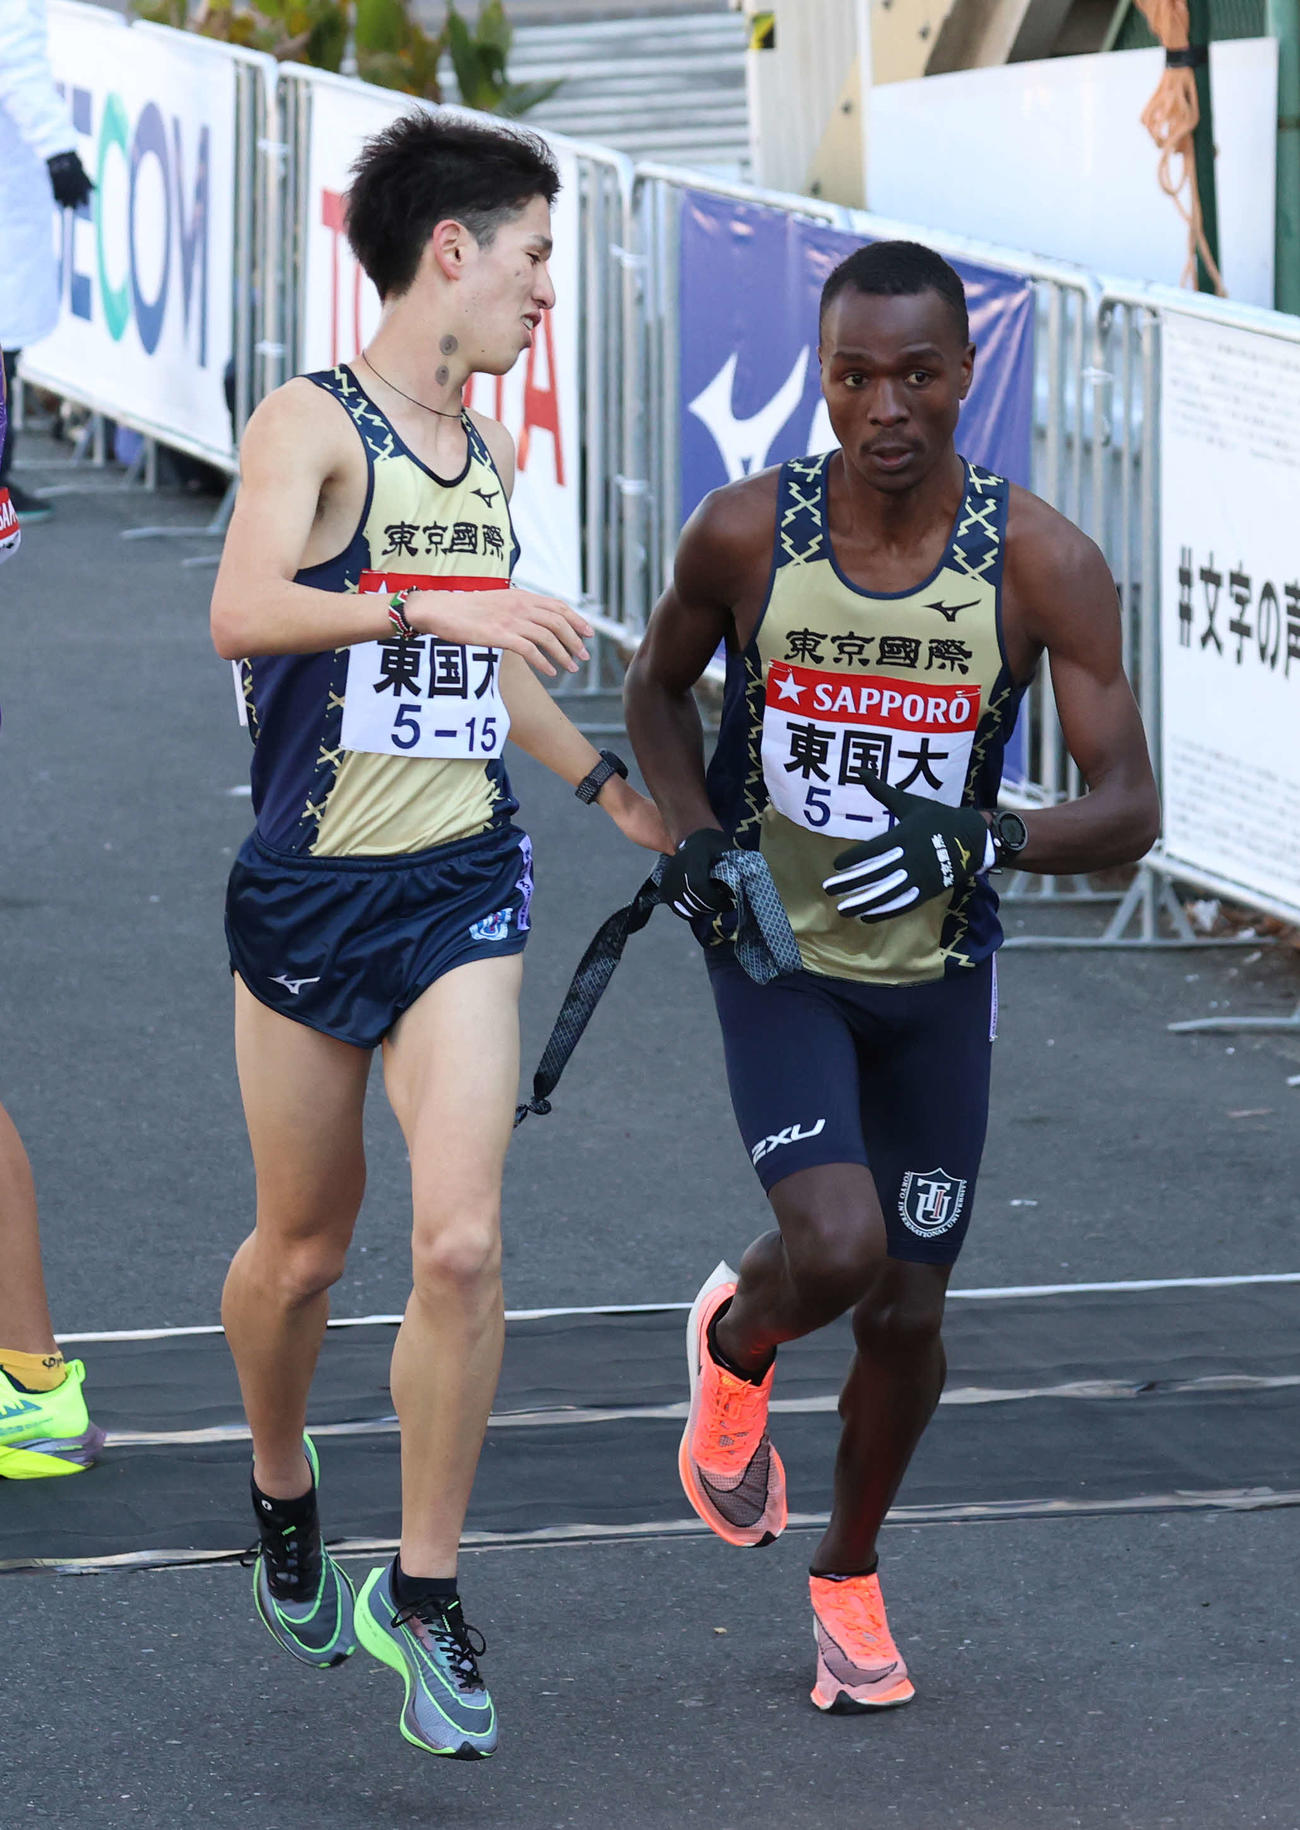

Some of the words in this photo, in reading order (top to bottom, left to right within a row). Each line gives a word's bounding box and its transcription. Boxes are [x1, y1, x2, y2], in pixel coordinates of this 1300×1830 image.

[54, 80, 210, 369] ECOM
[373, 637, 499, 700] 東国大
[784, 628, 972, 675] 東京國際
[391, 703, 497, 752] 5-15
[813, 683, 971, 724] SAPPORO
[783, 721, 949, 791] 東国大
